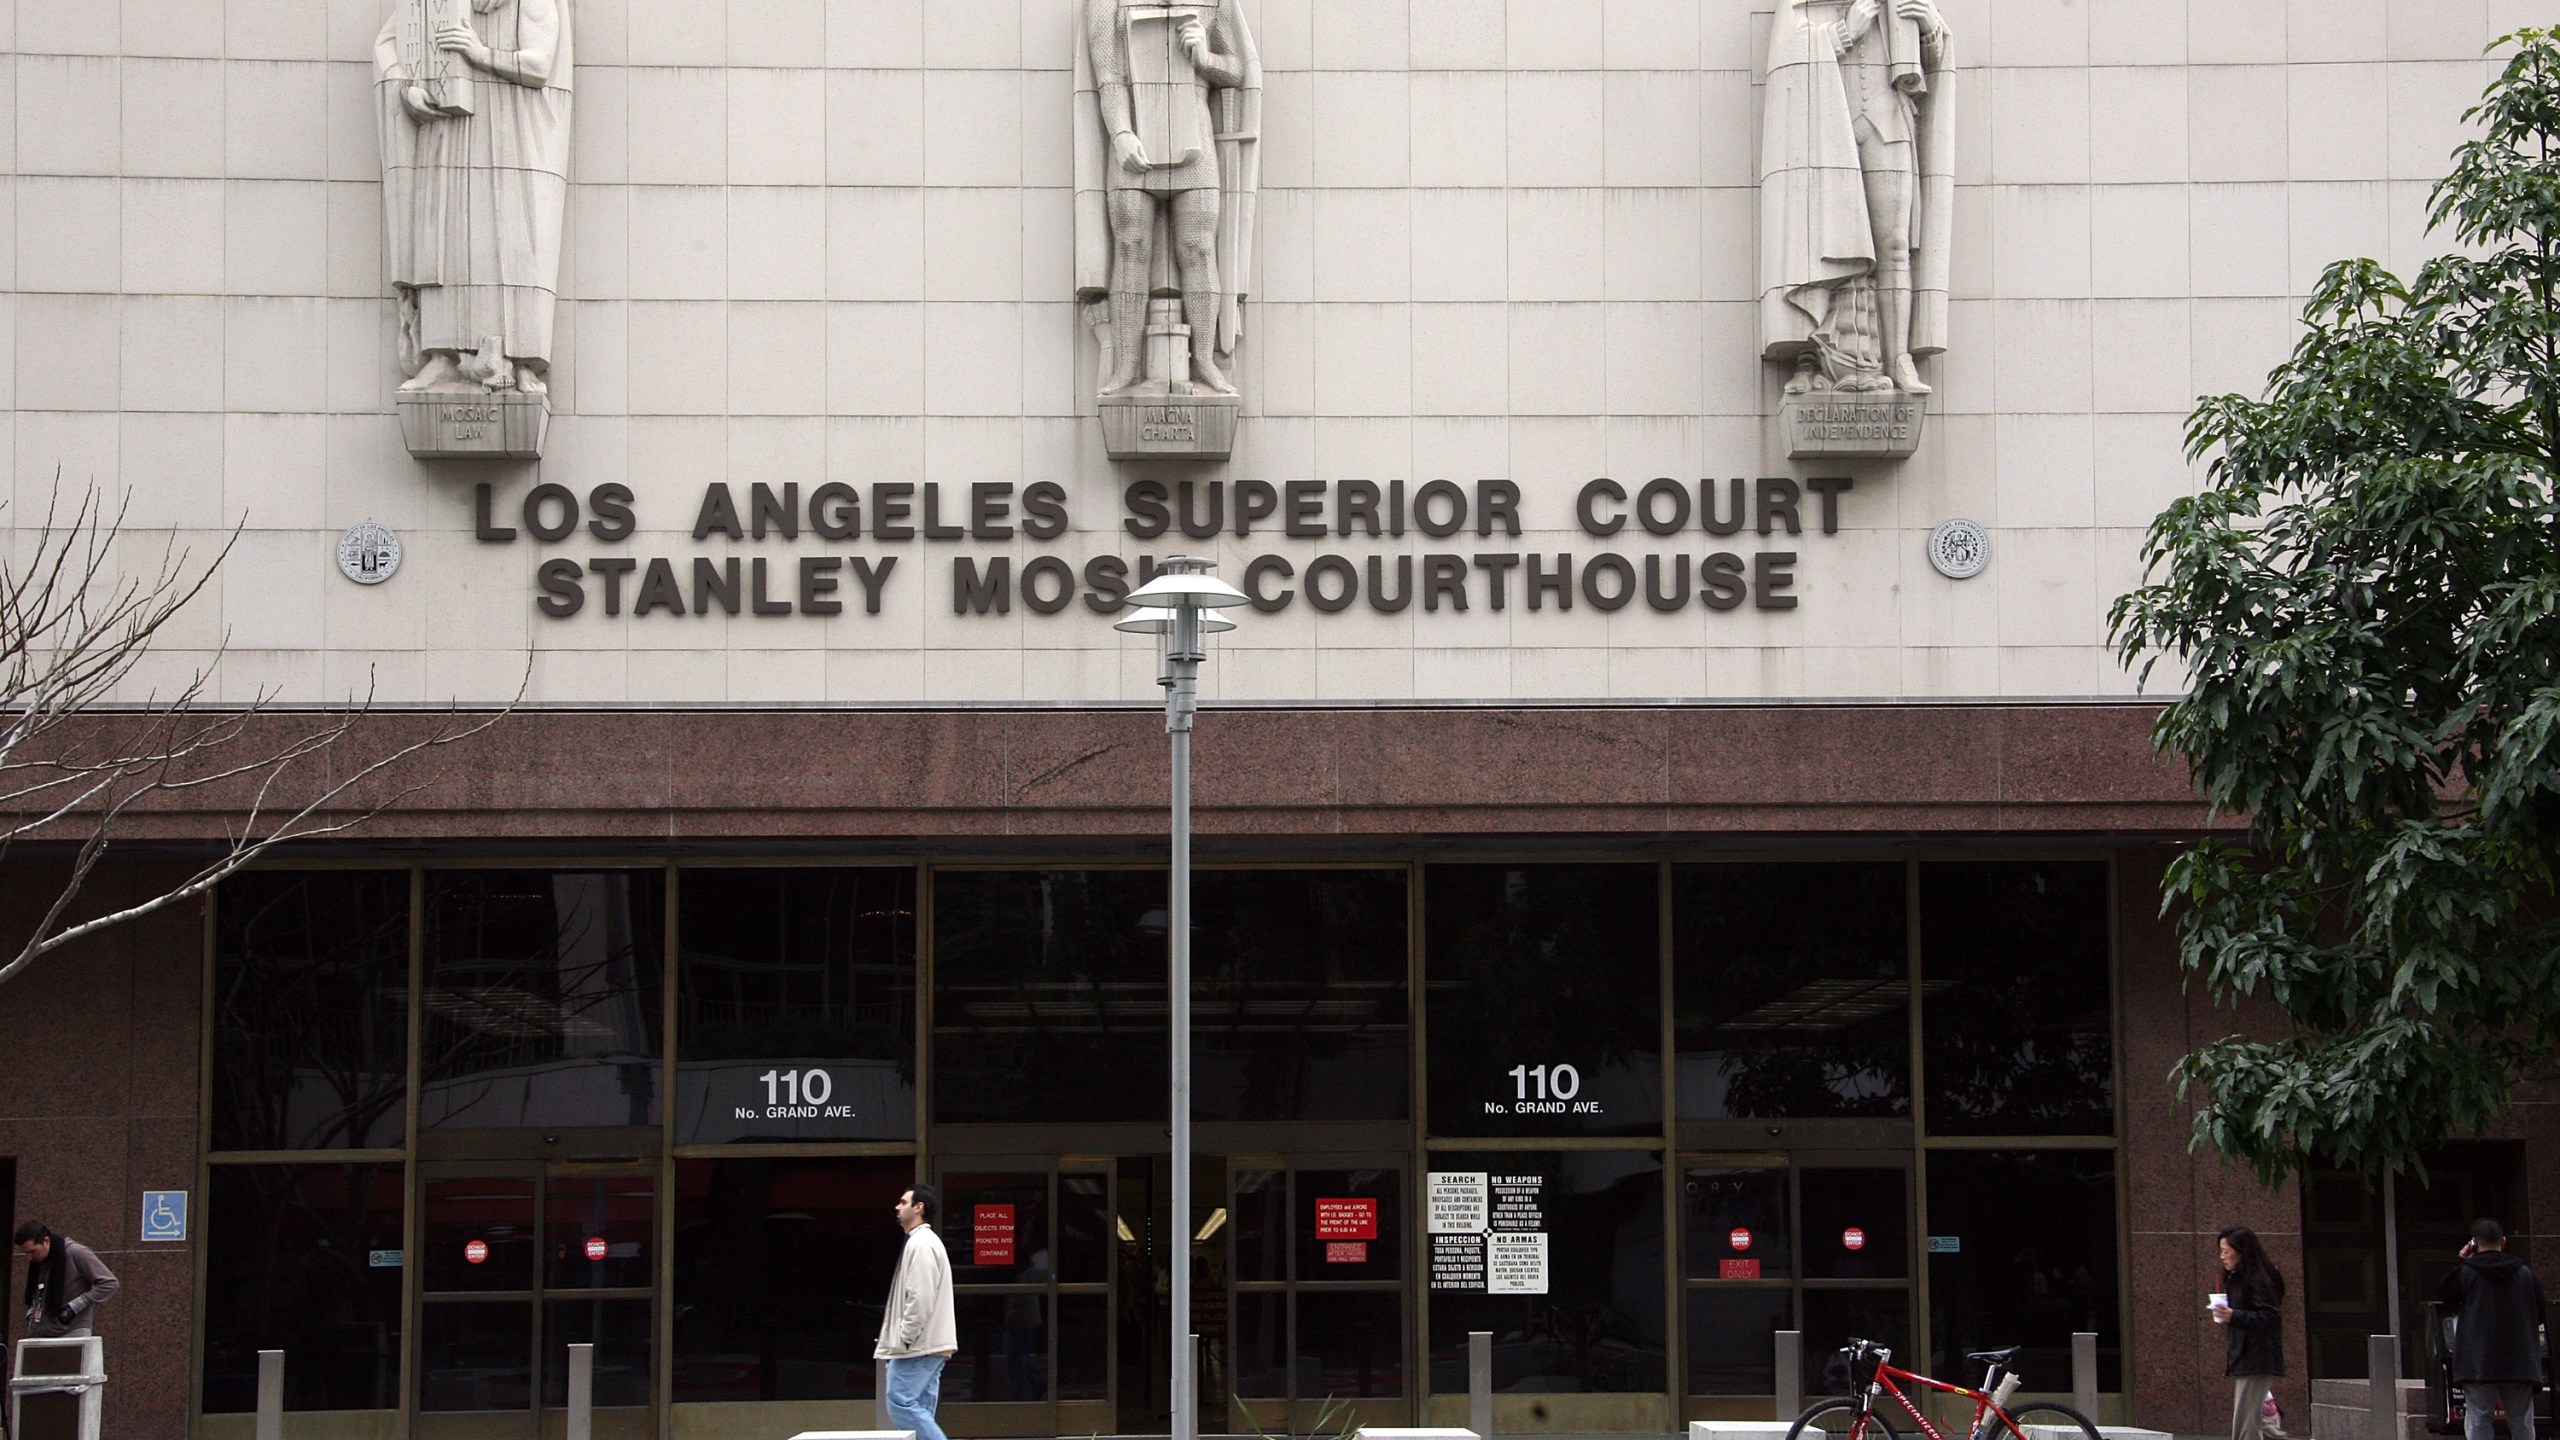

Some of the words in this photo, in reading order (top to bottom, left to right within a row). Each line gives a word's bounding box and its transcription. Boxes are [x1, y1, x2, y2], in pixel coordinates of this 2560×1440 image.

[434, 60, 450, 77] IX
[441, 405, 499, 422] MOSAIC
[1144, 405, 1194, 424] MAGNA
[1798, 405, 1889, 423] DECLARATION
[1896, 406, 1915, 422] OF
[456, 423, 487, 440] LAW
[1143, 425, 1195, 441] CHARTA
[1804, 424, 1907, 440] INDEPENDENCE
[475, 482, 636, 542] LOS
[692, 481, 1069, 542] ANGELES
[1124, 479, 1522, 541] SUPERIOR
[1577, 477, 1854, 537] COURT
[537, 556, 898, 618] STANLEY
[1244, 552, 1798, 614] COURTHOUSE
[760, 1068, 832, 1105] 110
[1508, 1063, 1580, 1100] 110
[735, 1107, 759, 1119] No.
[766, 1106, 818, 1118] GRAND
[824, 1105, 856, 1117] AVE.
[1485, 1102, 1508, 1113] No.
[1515, 1102, 1566, 1113] GRAND
[1573, 1102, 1603, 1113] AVE.
[1729, 1260, 1750, 1268] EXIT
[1727, 1270, 1752, 1278] ONLY
[1894, 1390, 1941, 1440] SPECIALIZED
